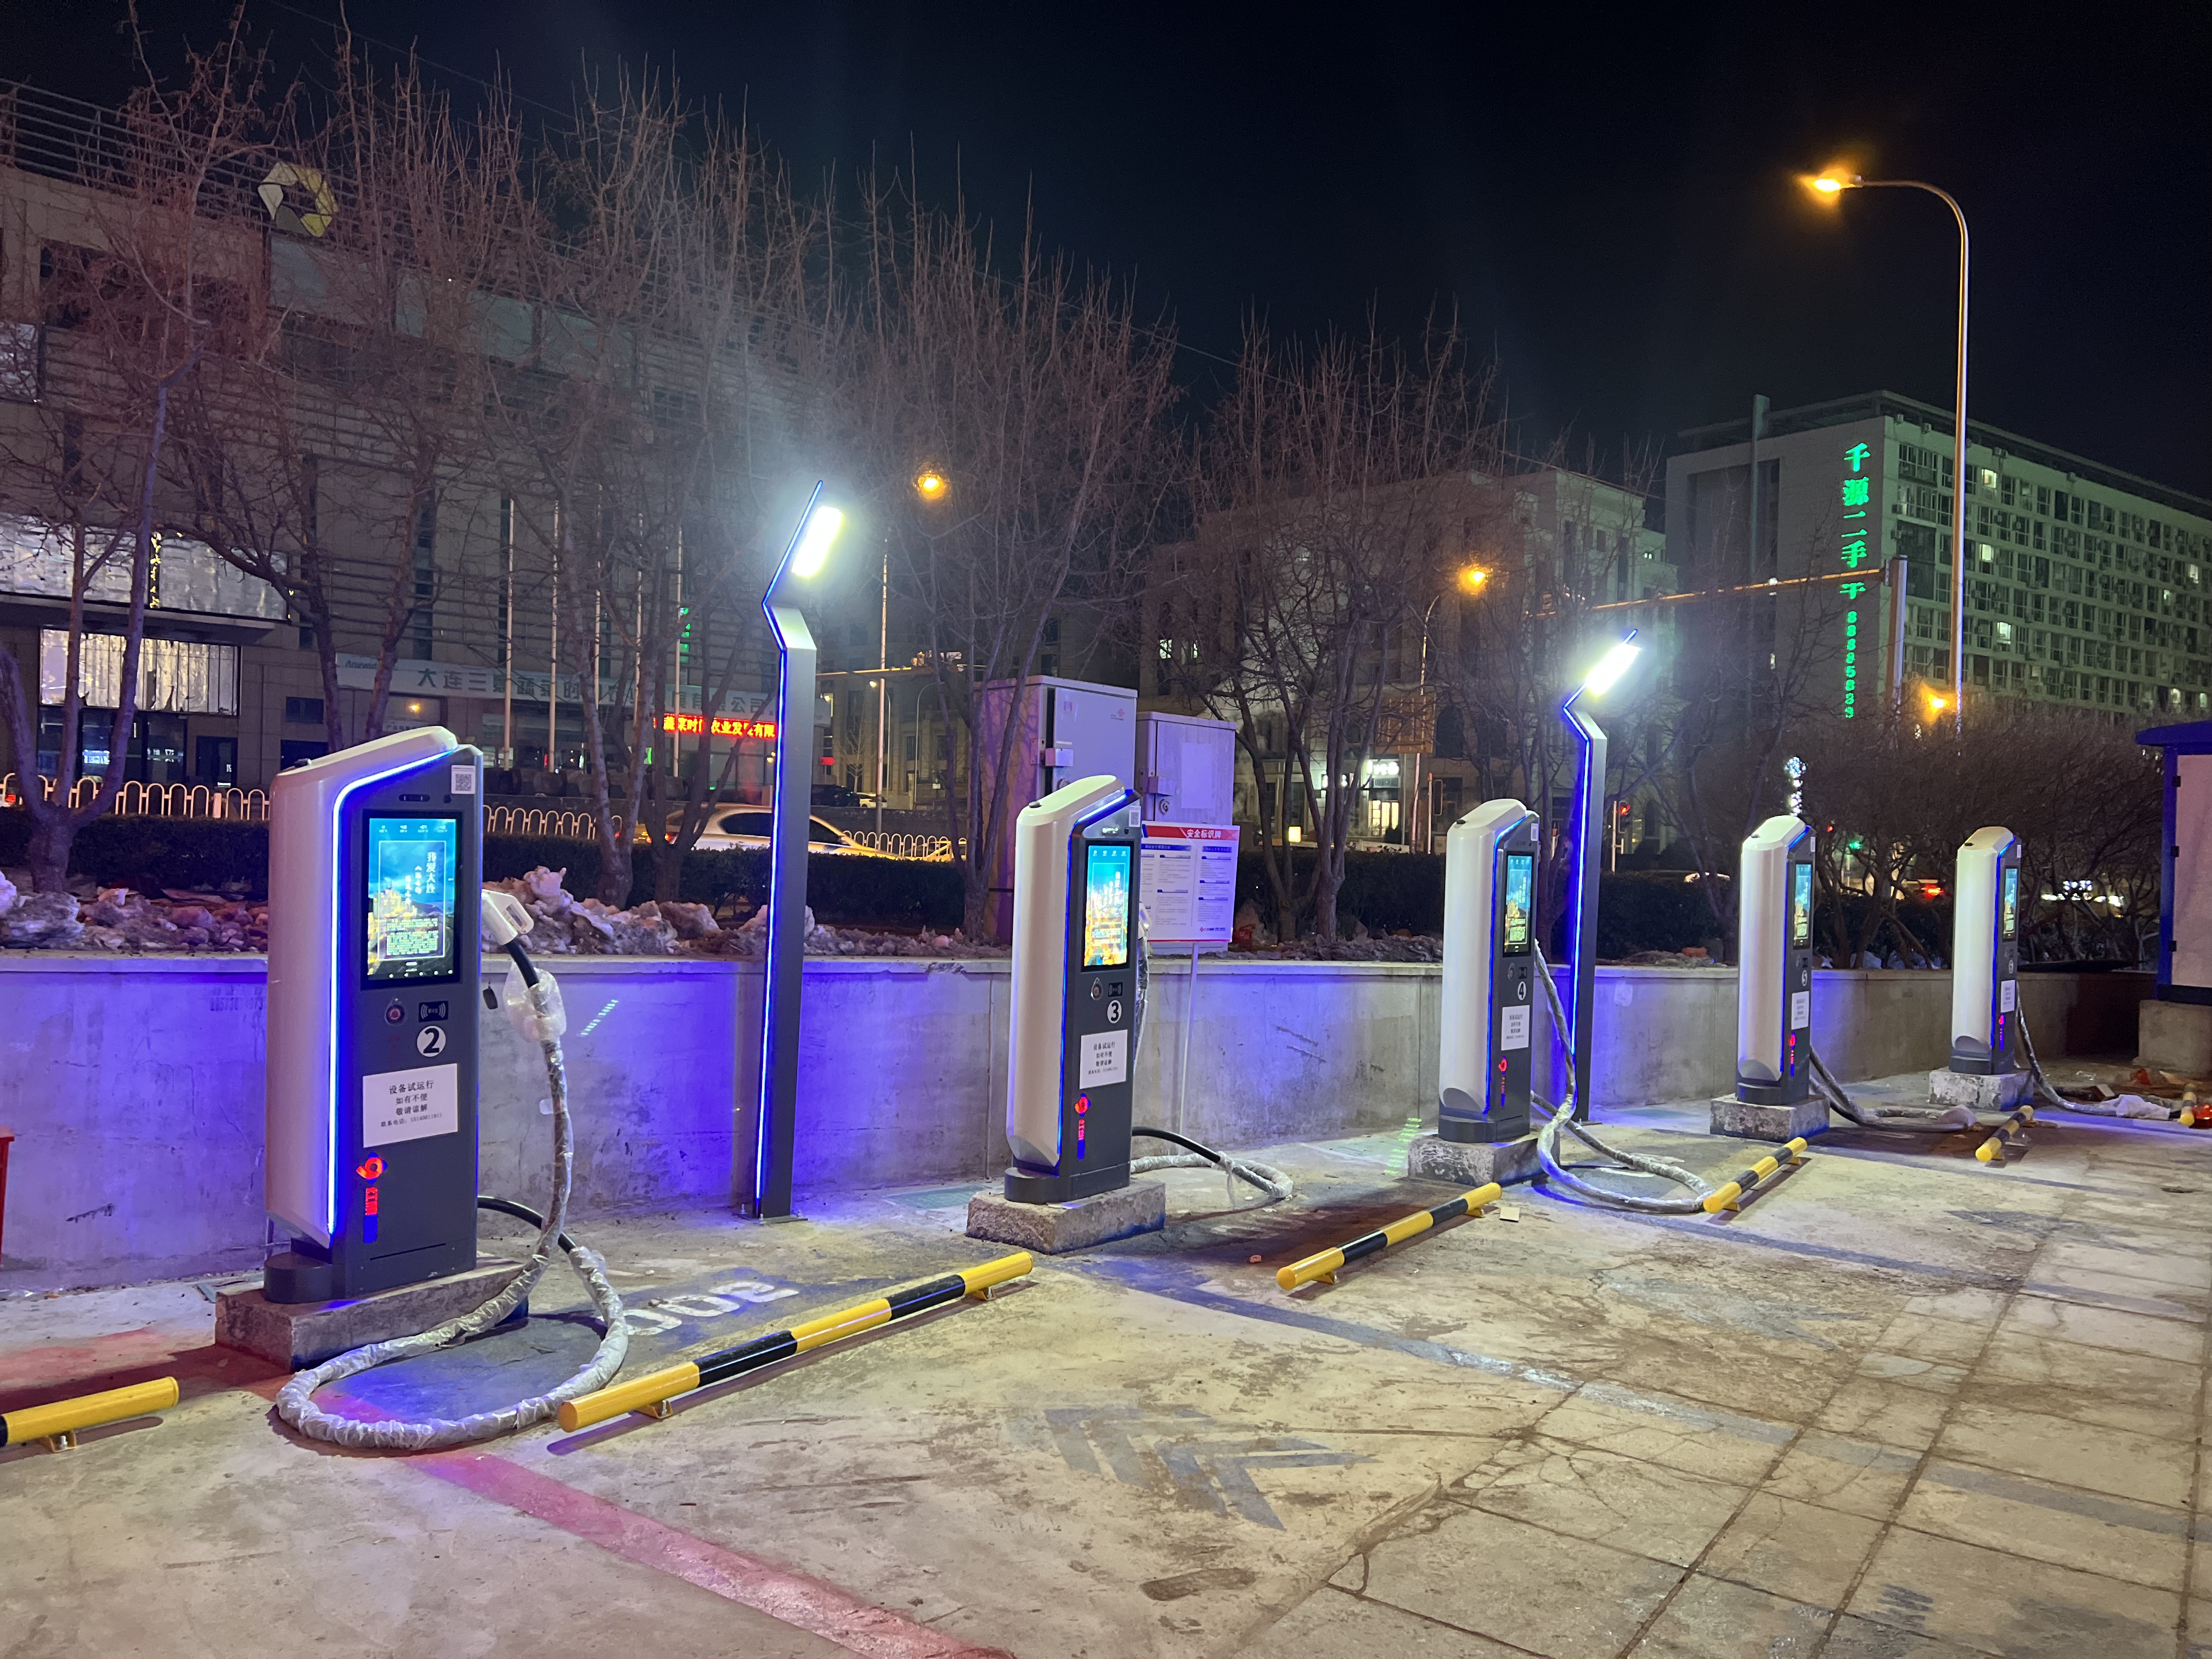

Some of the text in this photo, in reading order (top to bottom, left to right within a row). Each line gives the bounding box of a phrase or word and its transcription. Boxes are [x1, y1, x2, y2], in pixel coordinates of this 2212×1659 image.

[1187, 829, 1222, 839] 安全标识牌
[426, 851, 437, 894] 我爱大连
[1519, 983, 1524, 998] 4
[1110, 1002, 1119, 1021] 3
[423, 1028, 439, 1053] 2
[389, 1080, 434, 1094] 设备试运行
[396, 1093, 428, 1105] 如有不便
[396, 1104, 428, 1116] 敬请谅解
